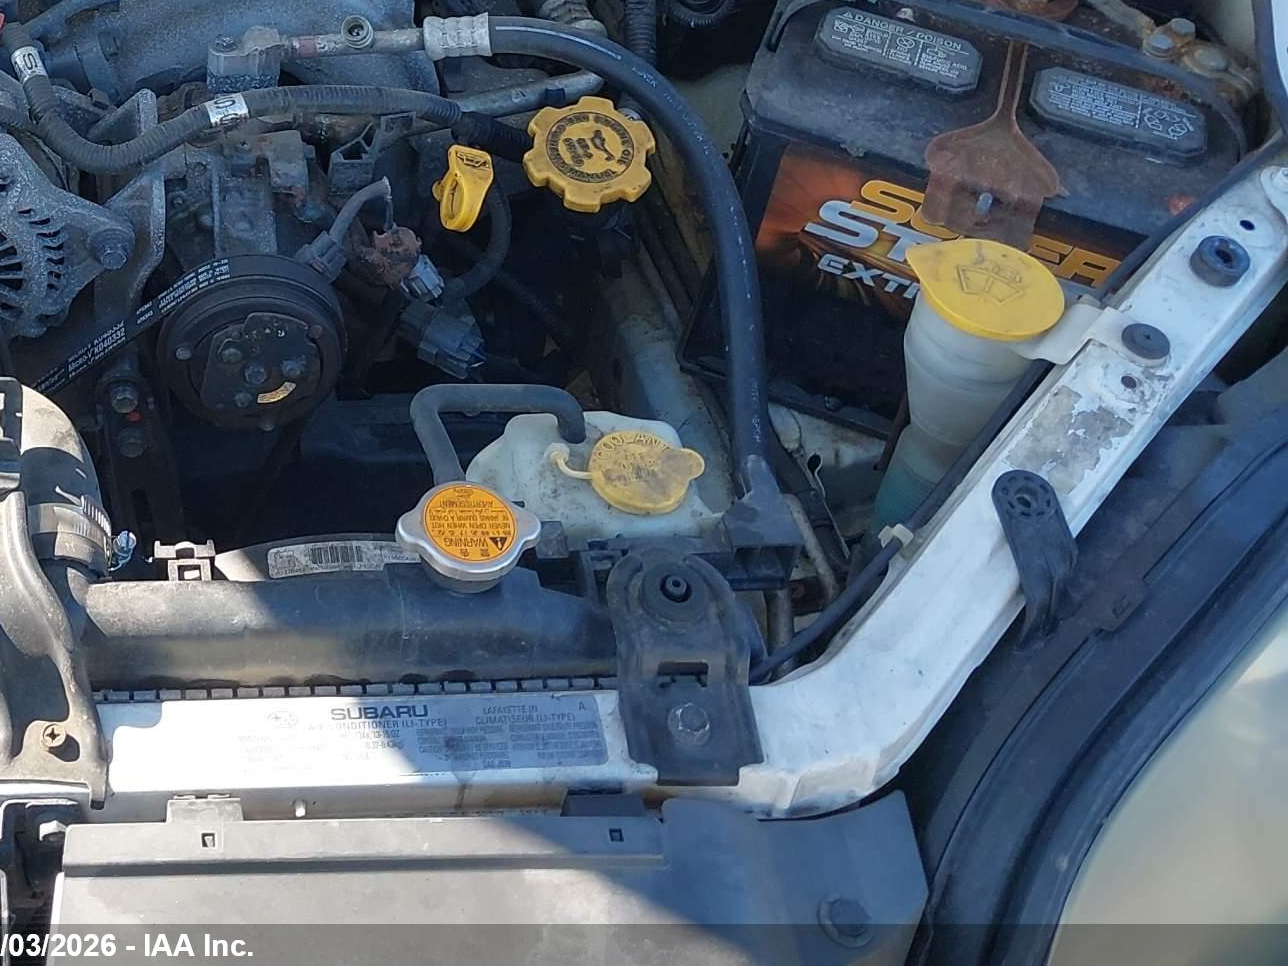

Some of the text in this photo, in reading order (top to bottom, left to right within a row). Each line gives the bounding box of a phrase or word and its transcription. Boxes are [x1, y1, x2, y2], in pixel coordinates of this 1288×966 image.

[855, 14, 904, 33] DANGER
[916, 32, 962, 51] POISON
[860, 179, 1123, 290] SER
[595, 433, 670, 460] COOLANT
[439, 499, 494, 508] AVERTISSEMENT
[445, 521, 468, 529] WHEN
[469, 521, 487, 529] OPEN
[488, 521, 511, 529] NEVER
[443, 537, 489, 548] WARNING
[578, 702, 587, 711] A
[330, 705, 429, 721] SUBARU
[401, 718, 448, 729] (LI-TYPE)
[475, 713, 576, 725] CLIMATISEUR (LI-TYPE)
